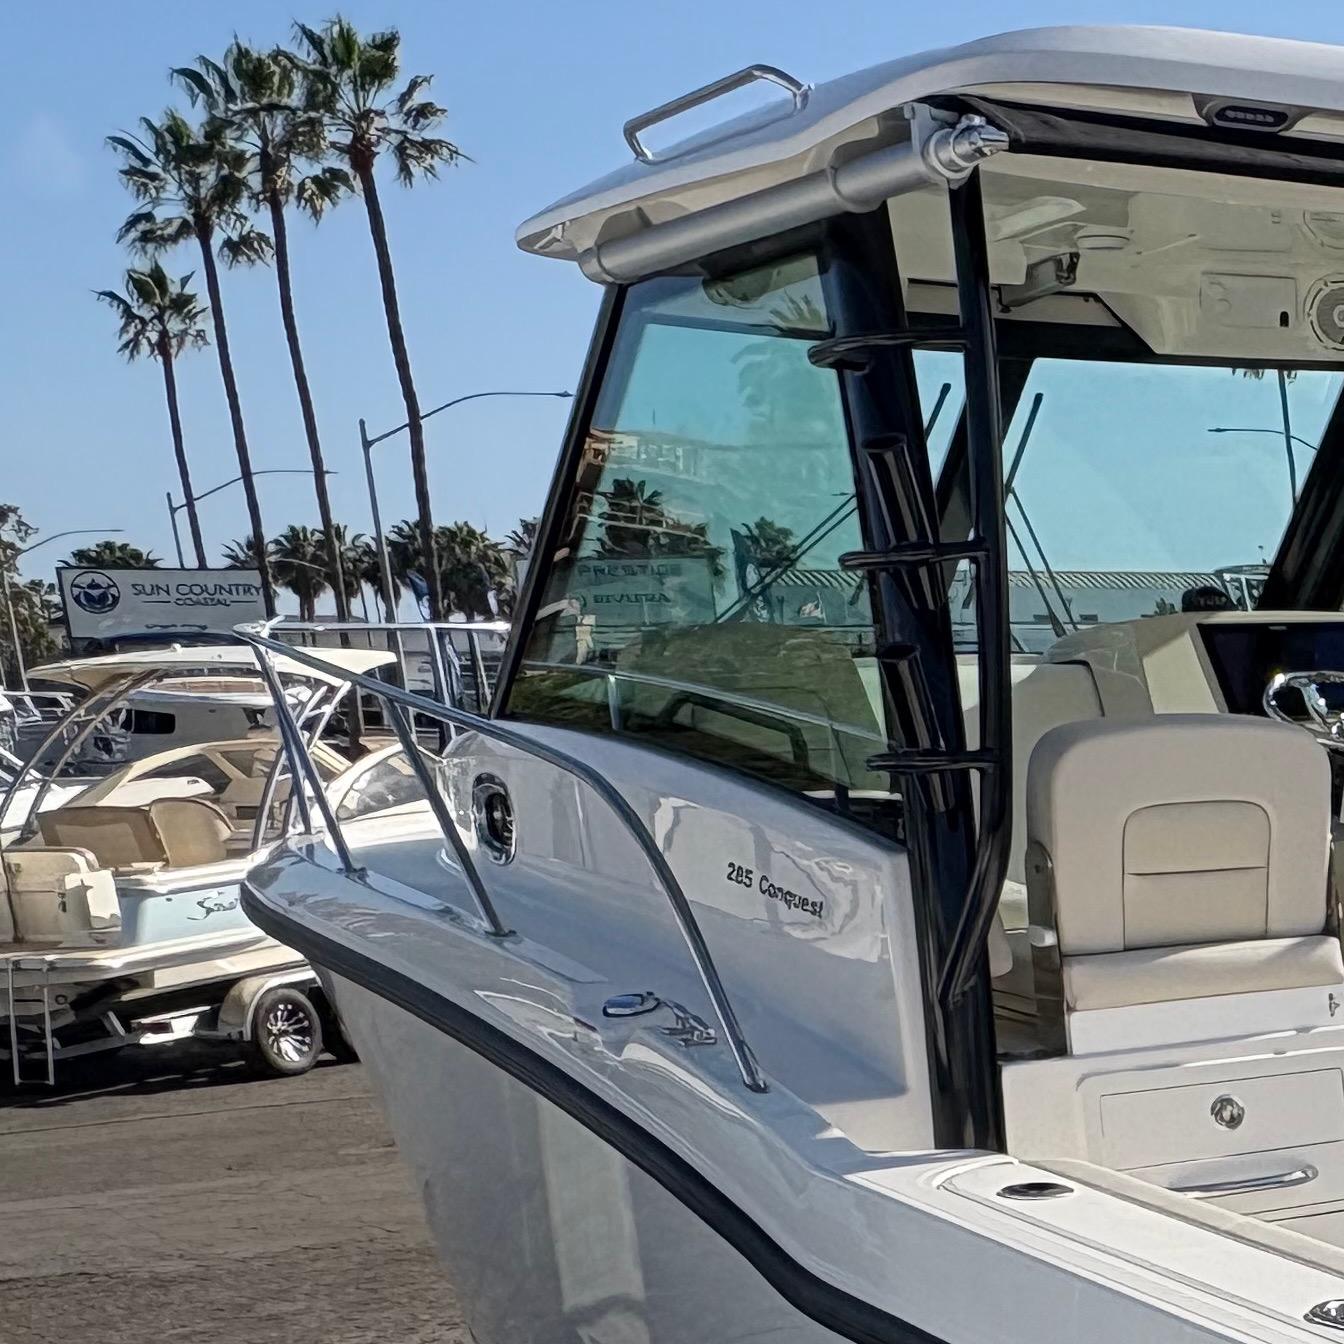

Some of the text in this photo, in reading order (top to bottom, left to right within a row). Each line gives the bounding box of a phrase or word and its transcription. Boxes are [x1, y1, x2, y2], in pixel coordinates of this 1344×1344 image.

[131, 583, 262, 596] SUN COUNTRY
[726, 861, 824, 920] 285 Conquest
